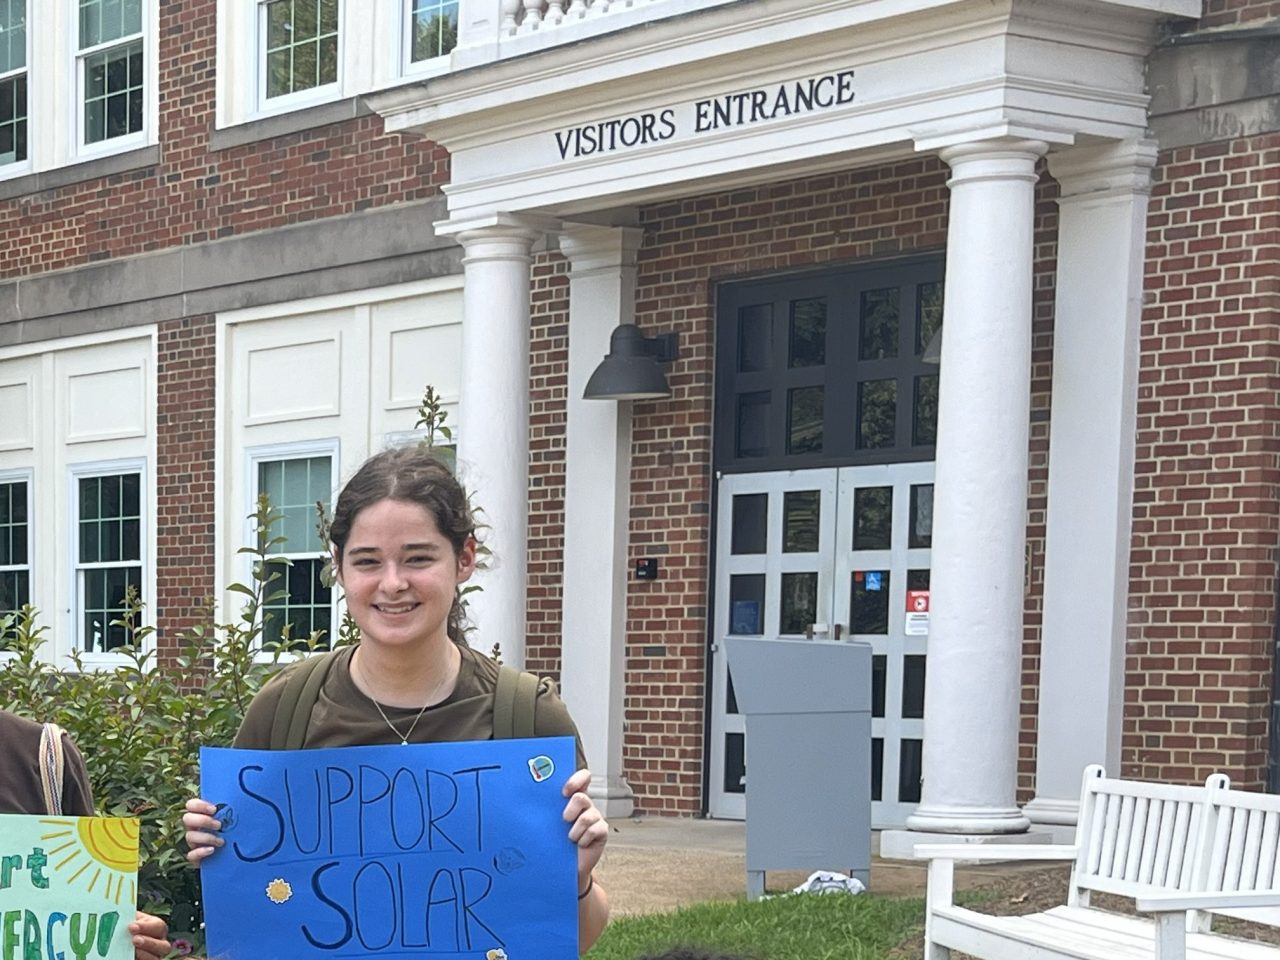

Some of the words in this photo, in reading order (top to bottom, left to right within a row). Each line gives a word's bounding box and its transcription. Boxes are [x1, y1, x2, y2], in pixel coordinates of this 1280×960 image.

[554, 109, 676, 160] VISITORS
[693, 70, 856, 133] ENTRANCE
[232, 764, 502, 863] SUPPORT
[301, 860, 506, 953] SOLAR
